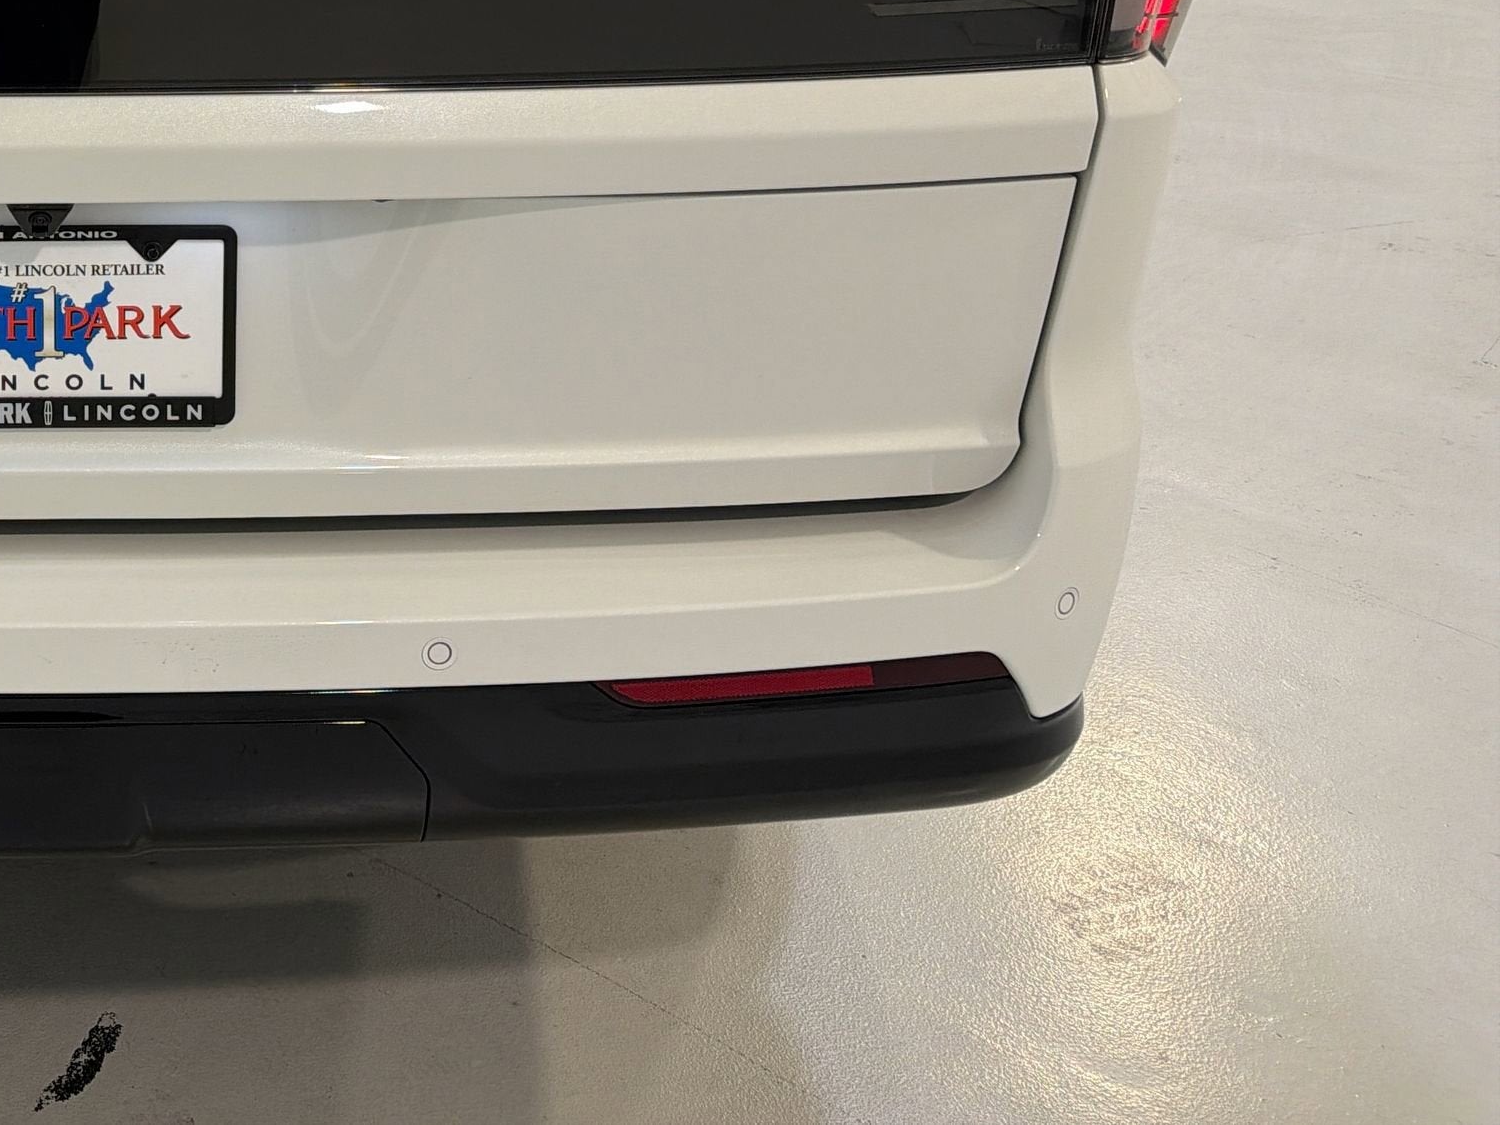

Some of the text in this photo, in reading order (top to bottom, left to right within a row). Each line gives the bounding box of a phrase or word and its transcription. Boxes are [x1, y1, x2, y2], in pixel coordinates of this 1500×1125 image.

[15, 264, 87, 276] LINCOLN
[91, 263, 166, 276] RETAILER
[62, 304, 191, 340] PARK
[63, 404, 203, 422] LINCOLN
